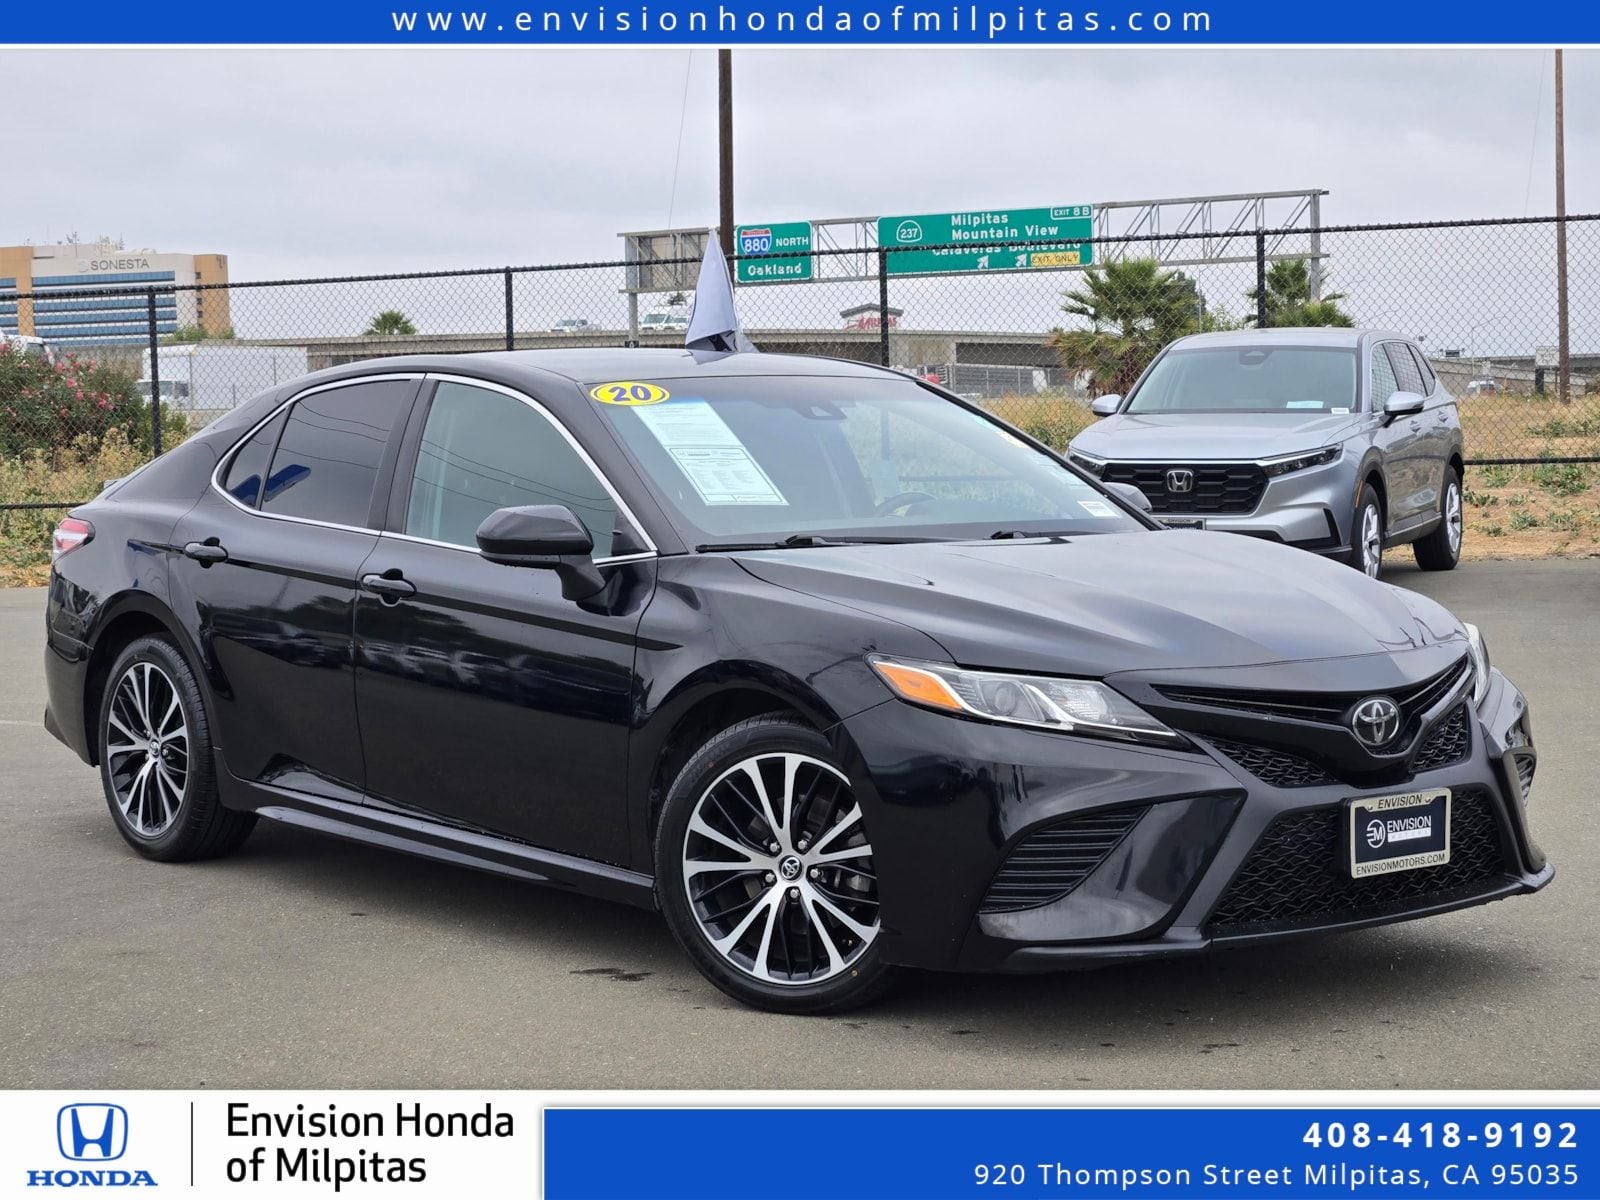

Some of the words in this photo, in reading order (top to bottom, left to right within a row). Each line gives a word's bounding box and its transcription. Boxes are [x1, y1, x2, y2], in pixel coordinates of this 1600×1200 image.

[951, 213, 1009, 228] Milpitas
[1053, 209, 1070, 217] EXIT
[900, 228, 918, 239] 237
[952, 227, 1018, 241] Mountain
[1025, 225, 1059, 237] View
[744, 238, 769, 252] 880
[775, 237, 809, 247] NORTH
[90, 258, 150, 271] SONESTA
[1032, 255, 1050, 264] EXIT
[1056, 254, 1078, 263] ONLY
[747, 263, 802, 276] Oakland
[608, 385, 652, 402] 20
[1378, 794, 1423, 809] ENVISION
[1386, 815, 1432, 833] ENVISION
[1356, 853, 1446, 875] ENVISIONMOTORS.COM
